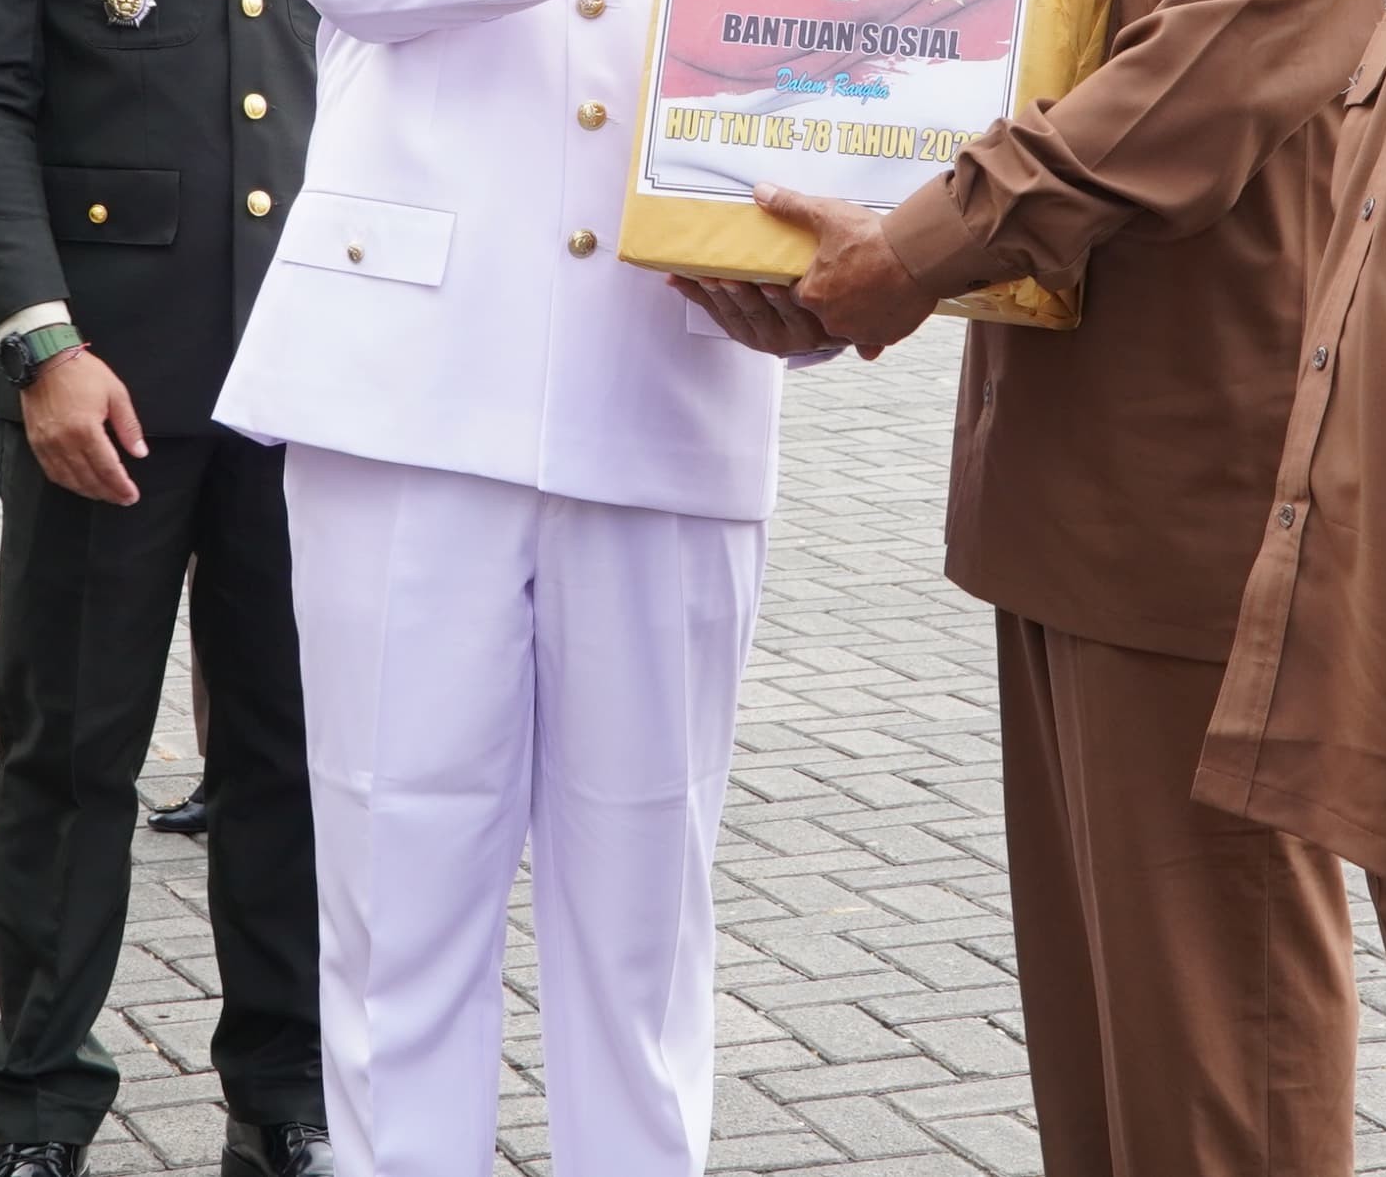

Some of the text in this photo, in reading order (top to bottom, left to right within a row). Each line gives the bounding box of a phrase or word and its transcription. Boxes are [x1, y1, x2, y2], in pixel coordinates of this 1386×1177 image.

[722, 12, 962, 60] BANTUAN SOSIAL
[776, 67, 891, 104] Dalam Rangka
[665, 107, 983, 164] HUT TNI KE-78 TAHUN 202
